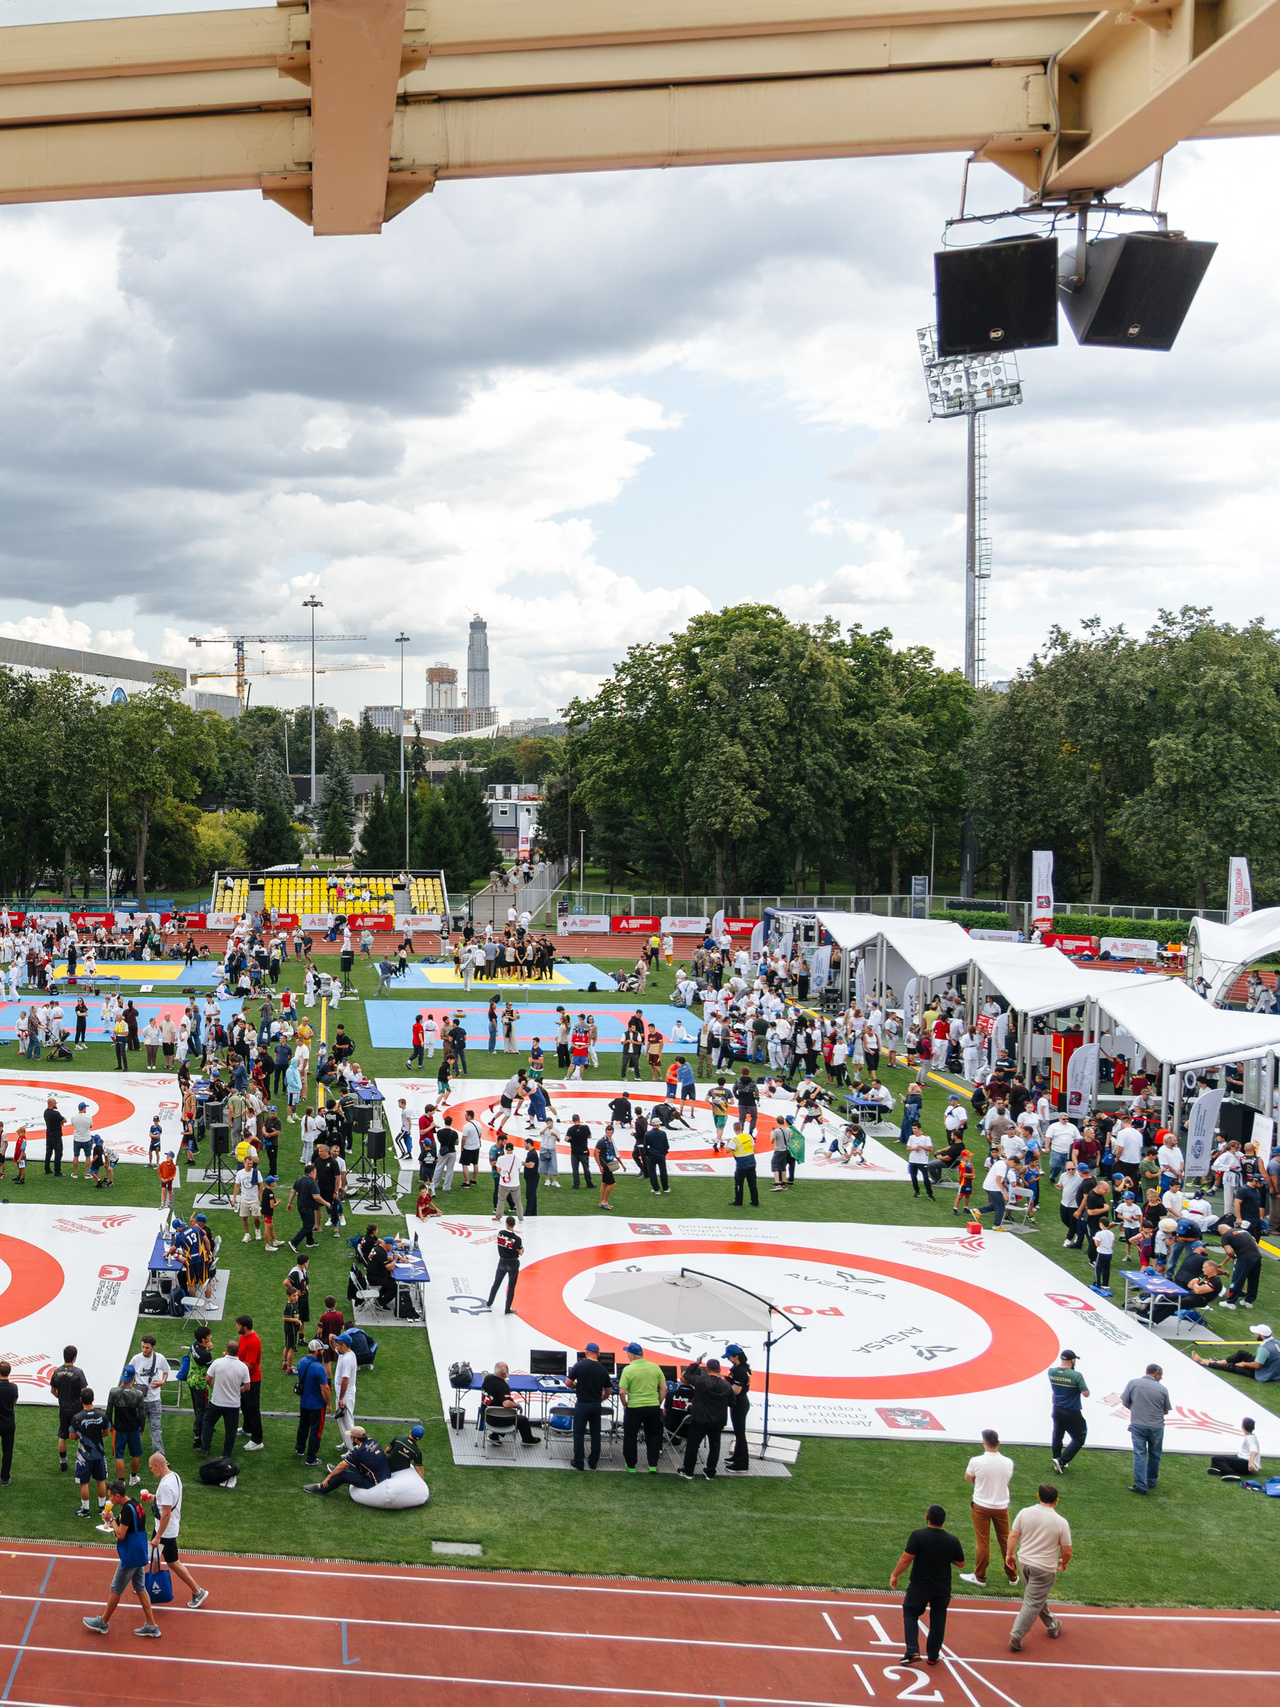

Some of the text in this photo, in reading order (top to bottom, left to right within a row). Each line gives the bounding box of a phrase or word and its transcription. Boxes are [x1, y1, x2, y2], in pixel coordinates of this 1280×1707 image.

[1234, 867, 1243, 906] МОСКОВСКИЙ
[677, 1223, 759, 1231] Департамент
[784, 1273, 886, 1300] AVEASA
[852, 1326, 924, 1354] AVEASA
[803, 1404, 862, 1412] города
[808, 1411, 867, 1419] спорта
[853, 1614, 907, 1646] 1
[882, 1665, 945, 1702] 2
